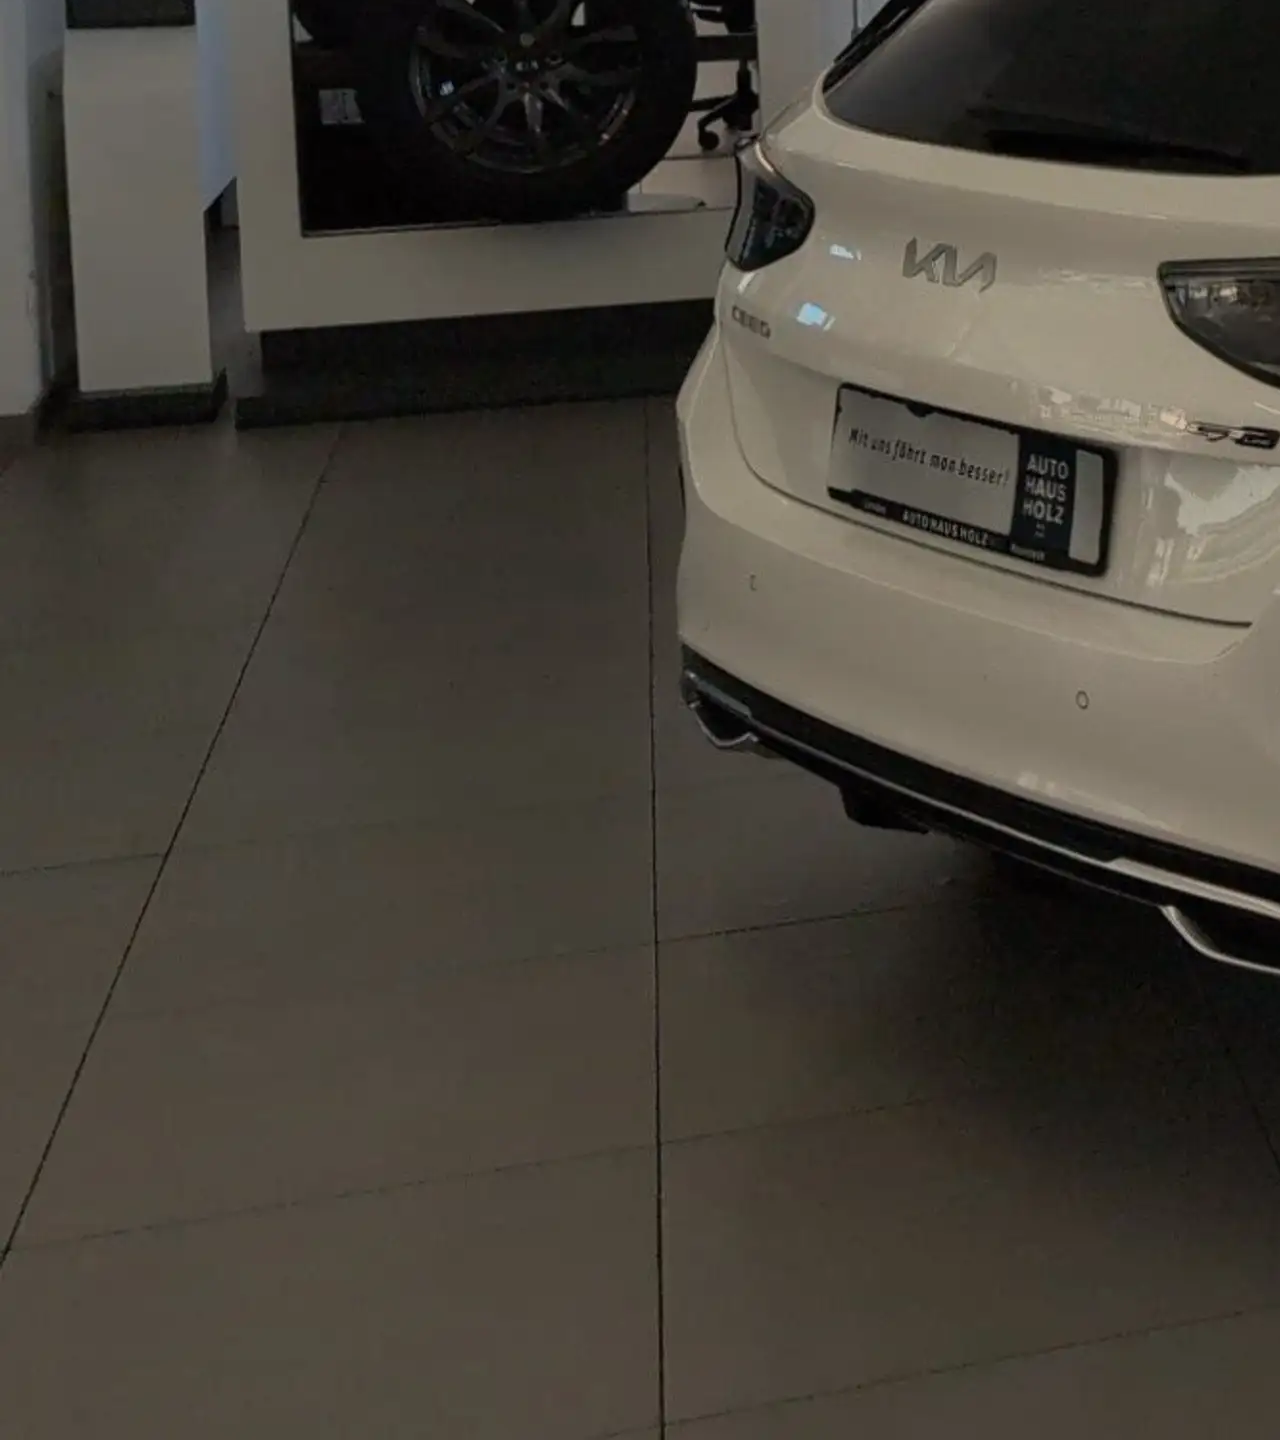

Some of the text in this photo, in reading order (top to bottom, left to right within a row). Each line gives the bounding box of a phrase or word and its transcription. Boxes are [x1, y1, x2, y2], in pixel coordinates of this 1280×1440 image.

[902, 236, 998, 293] KIA
[871, 437, 891, 455] uns
[1027, 453, 1070, 480] AUTO
[1024, 474, 1068, 503] HAUS
[1022, 498, 1065, 526] HOLZ
